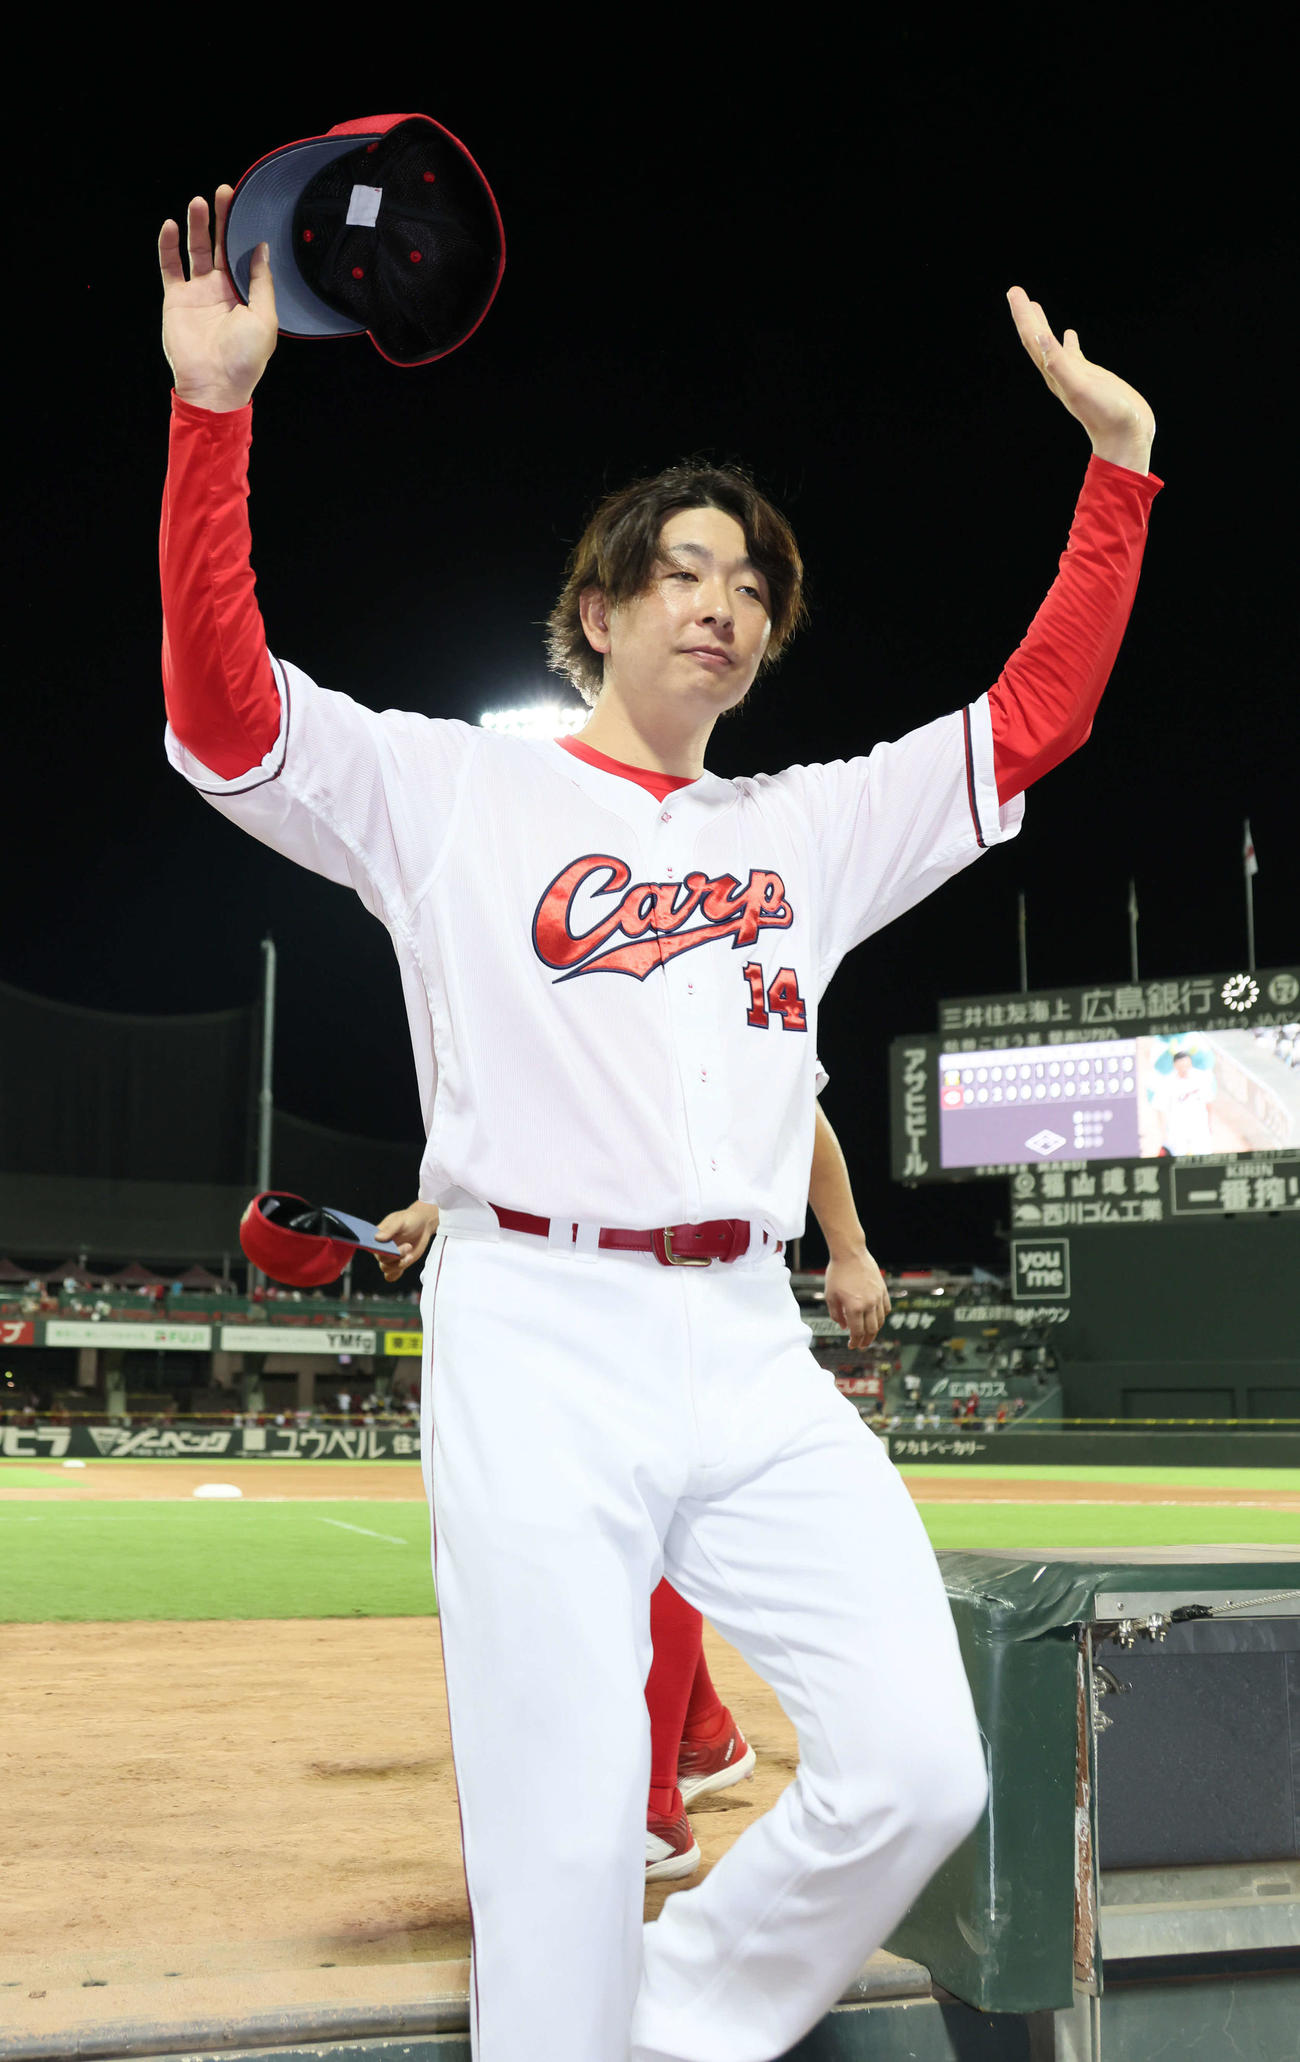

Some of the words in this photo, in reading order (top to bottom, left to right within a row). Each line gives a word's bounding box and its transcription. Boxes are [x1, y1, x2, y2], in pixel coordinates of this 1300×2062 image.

[532, 853, 793, 984] Carp
[742, 961, 808, 1032] 14
[1081, 979, 1215, 1023] 広島銀行
[942, 998, 1071, 1029] 三井住友海上
[1226, 1163, 1274, 1178] KIRIN
[1043, 1199, 1163, 1226] 西川ゴム工業
[1018, 1251, 1061, 1273] you
[1027, 1269, 1063, 1287] me
[0, 1322, 26, 1343] プ
[169, 1331, 206, 1345] FUJI
[326, 1333, 374, 1353] YMfg
[0, 1426, 72, 1457] ヒラ
